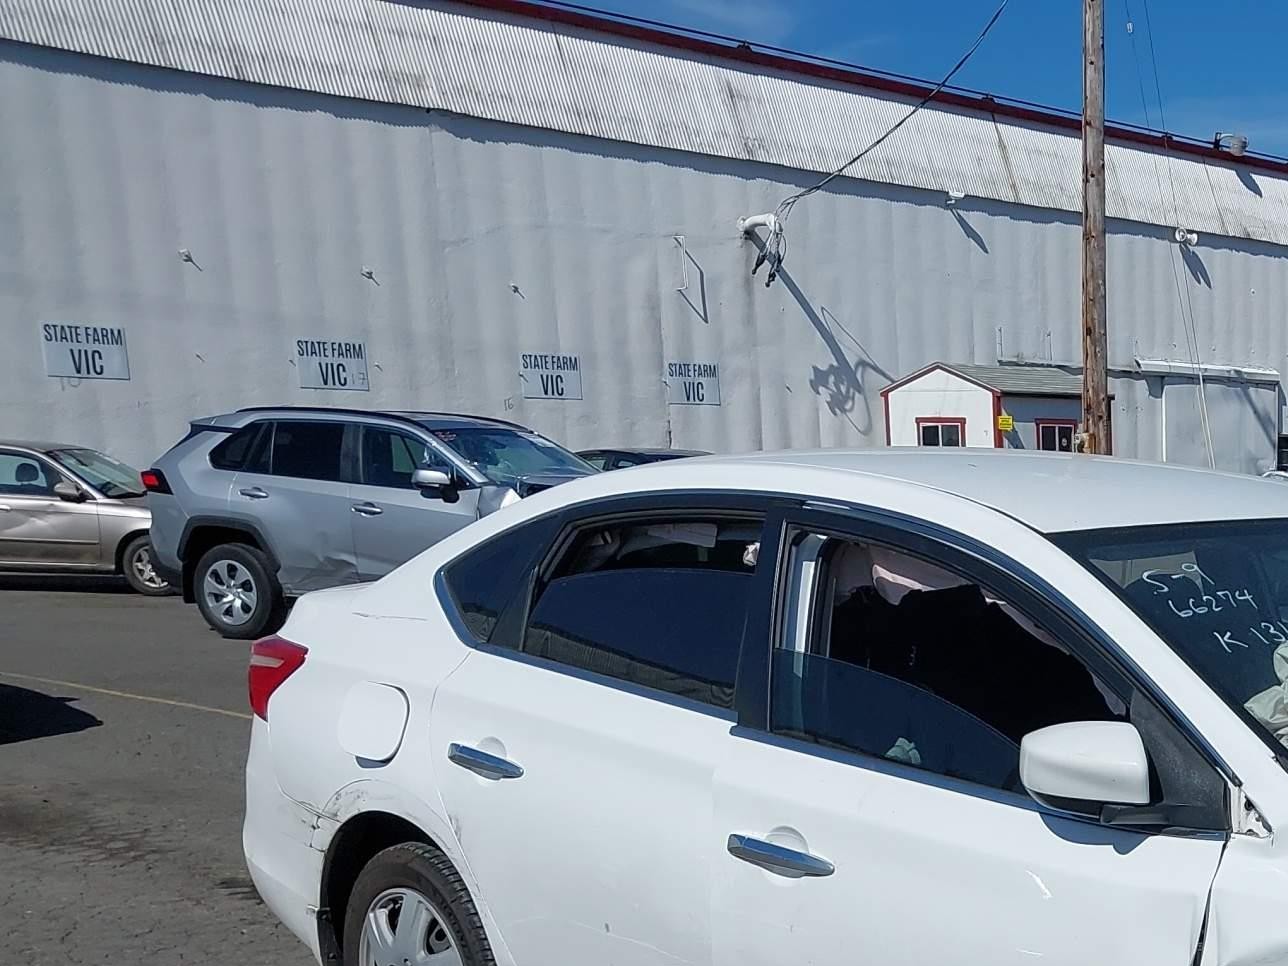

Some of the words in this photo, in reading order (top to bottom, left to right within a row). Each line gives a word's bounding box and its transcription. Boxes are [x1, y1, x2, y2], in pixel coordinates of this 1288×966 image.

[43, 323, 82, 344] STATE
[84, 326, 123, 346] FARM
[296, 339, 329, 358] STATE
[330, 342, 364, 360] FARM
[69, 348, 104, 376] VIC
[521, 354, 550, 370] STATE
[551, 355, 578, 371] FARM
[668, 362, 691, 378] STATE
[692, 363, 717, 379] FARM
[318, 361, 348, 387] VIC
[540, 374, 565, 396] VIC
[683, 381, 705, 402] VIC
[1168, 589, 1258, 618] 66274
[1213, 631, 1249, 653] K
